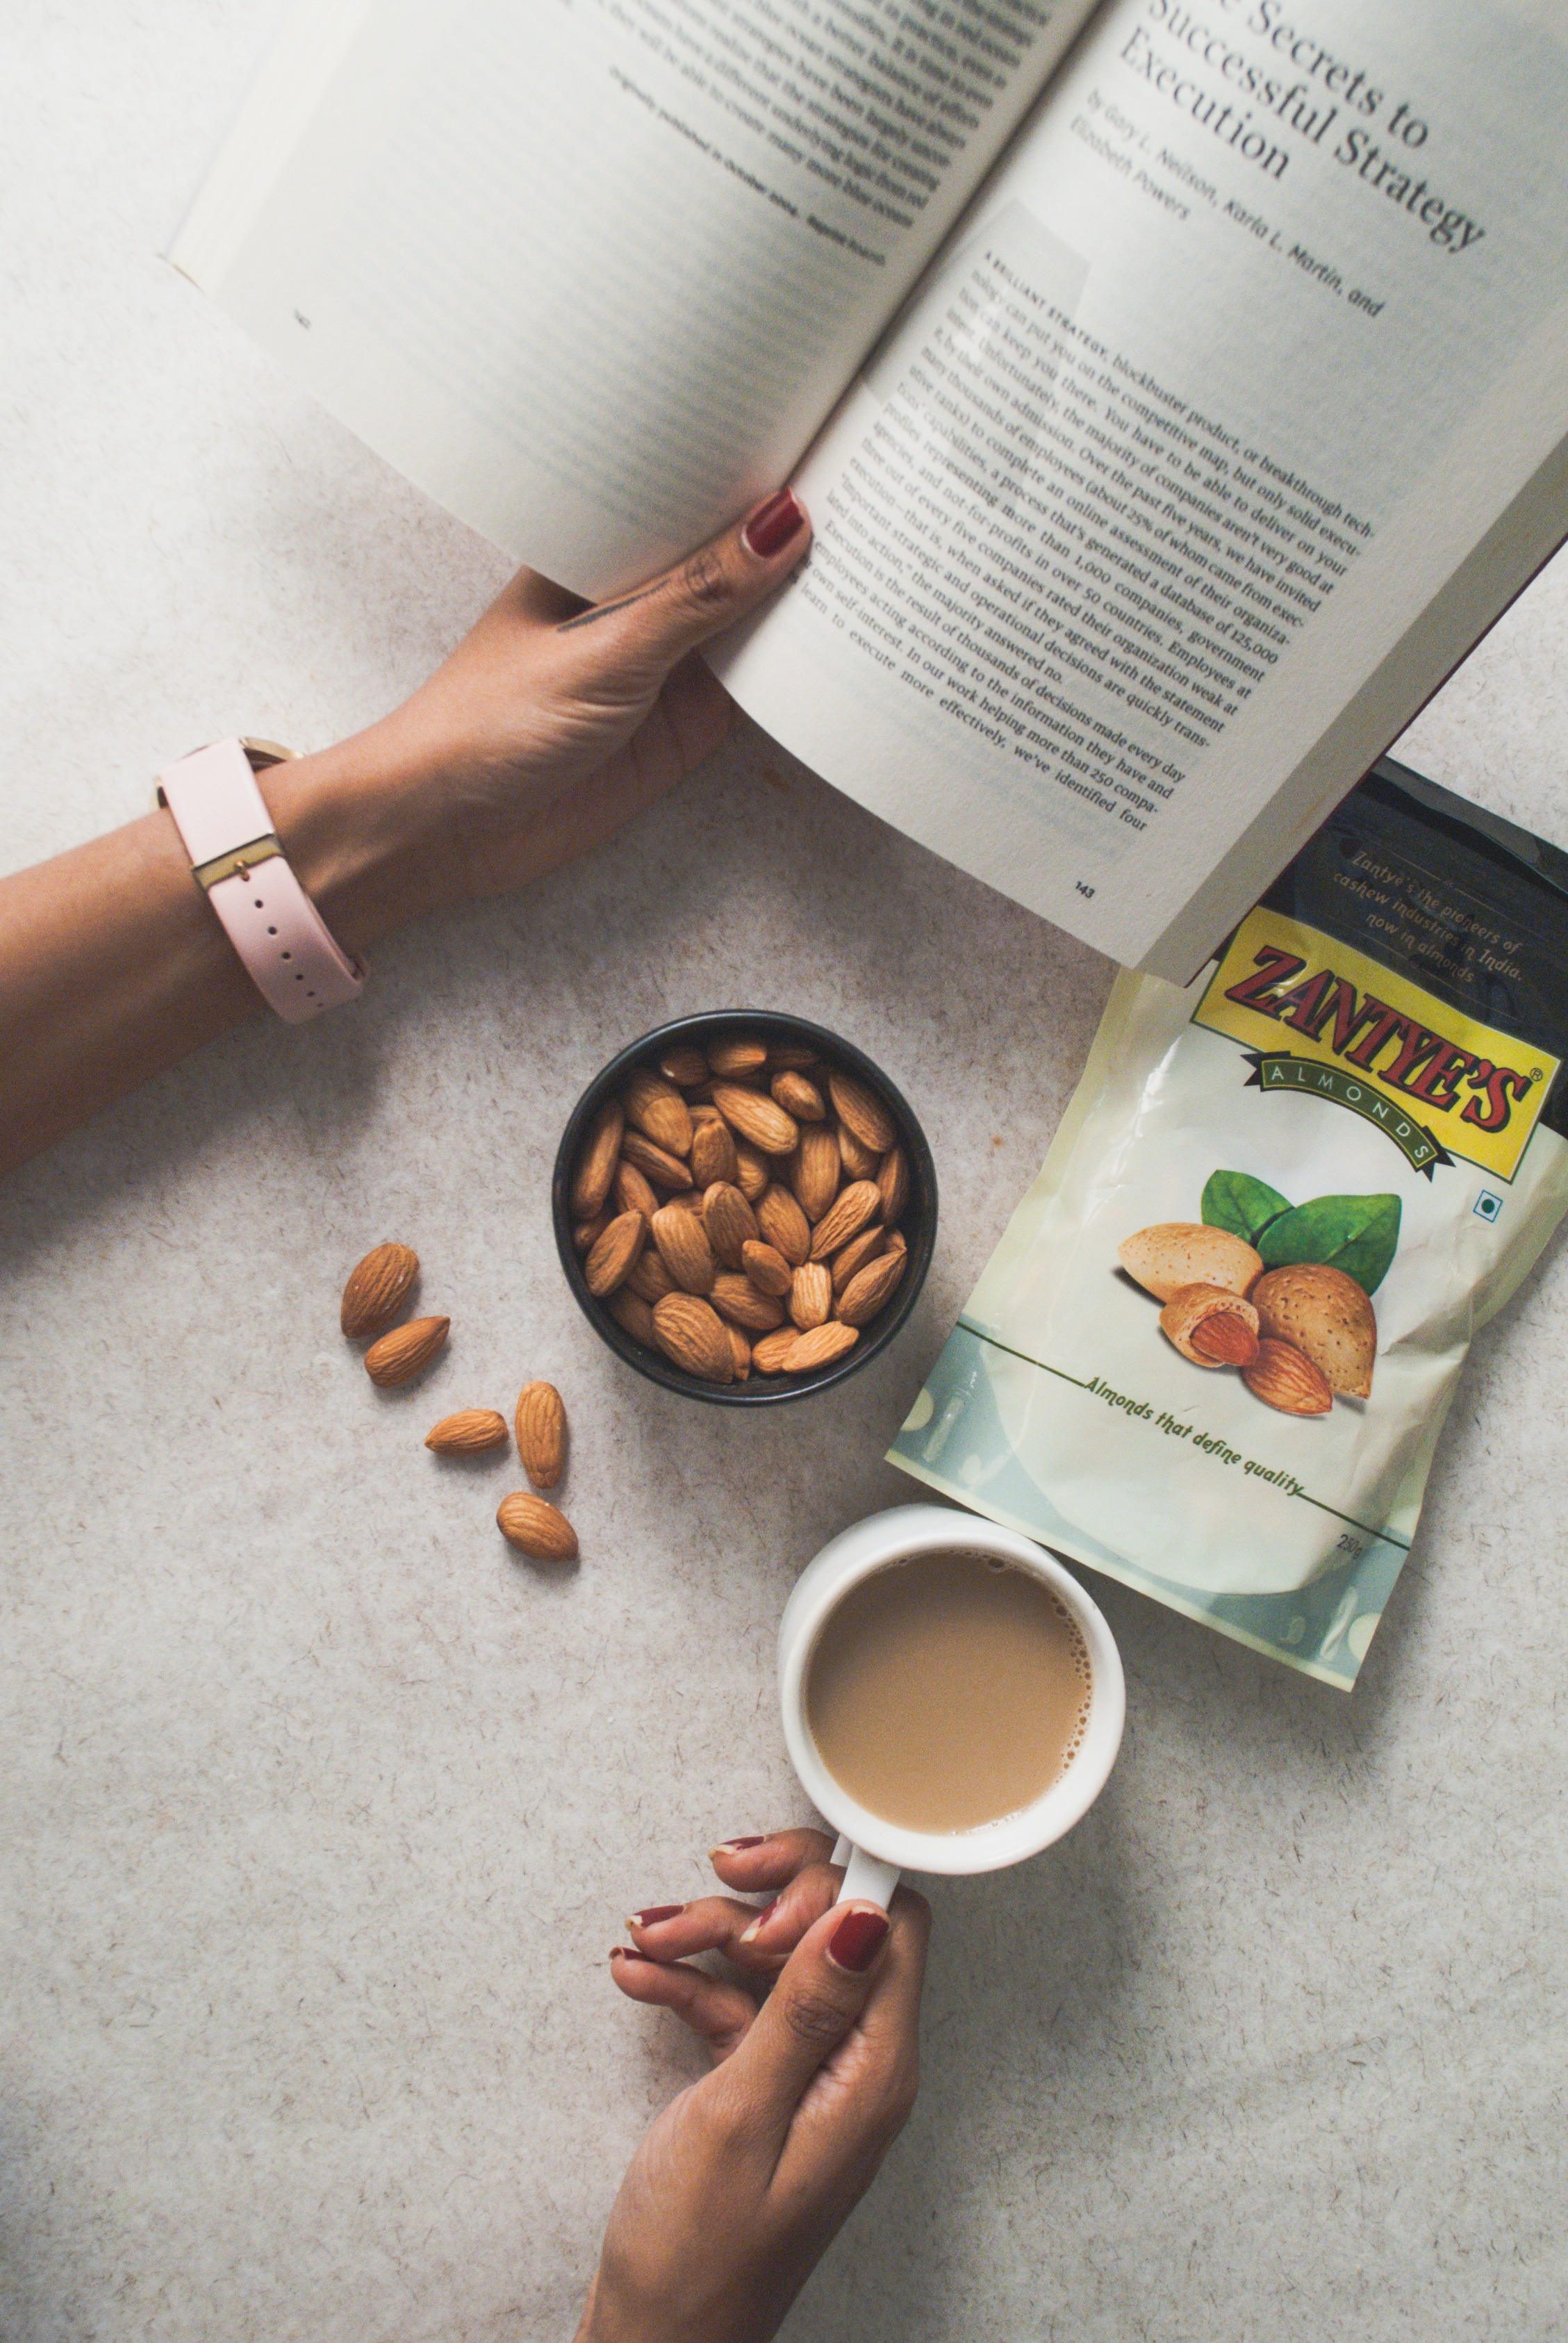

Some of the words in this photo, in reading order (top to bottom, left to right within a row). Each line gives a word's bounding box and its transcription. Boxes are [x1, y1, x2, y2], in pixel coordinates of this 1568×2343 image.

[1119, 24, 1291, 180] Execution
[1149, 0, 1337, 144] Successful
[1334, 127, 1485, 254] Strategy
[1248, 0, 1384, 115] Secrets
[1387, 100, 1428, 148] to
[1069, 115, 1134, 176] Elizabeth
[1133, 169, 1191, 221] Powers
[1156, 147, 1218, 207] Neilson,
[1222, 198, 1269, 240] Karla
[1269, 231, 1283, 251] L.
[1287, 243, 1343, 296] Martin,
[1347, 287, 1387, 318] and
[1062, 405, 1086, 429] the
[1084, 423, 1140, 470] majority
[1139, 461, 1157, 478] of
[1154, 472, 1223, 523] companies
[1221, 516, 1261, 546] aren't
[1259, 541, 1289, 567] very
[1285, 559, 1322, 585] good
[1319, 579, 1335, 594] at
[1096, 372, 1121, 395] the
[1121, 390, 1199, 450] competitive
[1198, 445, 1229, 473] map,
[1232, 464, 1258, 488] but
[1256, 483, 1287, 511] only
[1287, 502, 1322, 529] solid
[1319, 523, 1361, 554] execu-
[1103, 404, 1130, 431] You
[1131, 425, 1165, 456] have
[1166, 450, 1183, 468] to
[1182, 460, 1202, 480] be
[1203, 476, 1233, 500] able
[1232, 494, 1250, 511] to
[1250, 504, 1296, 541] deliver
[1296, 537, 1317, 554] on
[1315, 550, 1348, 575] your
[1111, 352, 1187, 414] blockbuster
[1185, 409, 1241, 453] product,
[1242, 446, 1260, 463] or
[1258, 454, 1345, 518] breakthrough
[1343, 511, 1374, 536] tech-
[1000, 502, 1037, 534] more
[1039, 529, 1072, 558] than
[1074, 554, 1112, 584] 1,000
[1113, 580, 1183, 634] companies,
[1187, 628, 1266, 682] government
[1046, 480, 1065, 498] an
[1065, 493, 1109, 529] online
[1109, 524, 1184, 577] assessment
[1183, 572, 1203, 589] of
[1200, 581, 1232, 609] their
[1232, 603, 1289, 644] organiza-
[1078, 444, 1110, 475] Over
[1109, 468, 1134, 491] the
[1130, 485, 1163, 509] past
[1161, 501, 1187, 526] five
[1185, 520, 1221, 552] years,
[1224, 545, 1246, 564] we
[1244, 555, 1276, 584] have
[1275, 575, 1321, 612] invited
[1082, 477, 1129, 513] (about
[1126, 507, 1157, 532] 25%
[1153, 525, 1172, 542] of
[1168, 535, 1210, 567] whom
[1207, 561, 1243, 589] came
[1241, 579, 1273, 608] from
[1271, 602, 1304, 627] exec-
[1084, 535, 1152, 582] generated
[1160, 580, 1216, 624] database
[1214, 618, 1234, 634] of
[1230, 628, 1279, 664] 125,000
[905, 593, 943, 625] result
[941, 620, 959, 636] of
[956, 629, 1021, 680] thousands
[1019, 674, 1038, 689] of
[1034, 680, 1094, 725] decisions
[1092, 719, 1128, 747] made
[1126, 741, 1163, 771] every
[1161, 759, 1186, 786] day
[910, 568, 933, 593] the
[932, 587, 984, 633] majority
[984, 625, 1046, 671] answered
[1043, 664, 1062, 684] no.
[943, 568, 972, 593] and
[969, 588, 1046, 644] operational
[1043, 636, 1105, 683] decisions
[1103, 677, 1127, 696] are
[1123, 691, 1173, 728] quickly
[1173, 718, 1210, 747] trans-
[946, 543, 982, 576] when
[982, 570, 1023, 603] asked
[1021, 595, 1036, 611] if
[1033, 605, 1064, 635] they
[1064, 627, 1111, 660] agreed
[1108, 655, 1141, 680] with
[1139, 673, 1163, 694] the
[1162, 688, 1225, 733] statement
[952, 517, 978, 545] five
[977, 539, 1046, 593] companies
[1046, 588, 1083, 616] rated
[1080, 609, 1113, 636] their
[1112, 631, 1191, 686] organization
[1190, 680, 1225, 707] weak
[1223, 701, 1239, 716] at
[1034, 551, 1050, 570] in
[1050, 565, 1082, 591] over
[1082, 586, 1103, 604] 50
[1102, 599, 1163, 645] countries.
[1168, 638, 1236, 689] Employees
[1236, 684, 1253, 699] at
[900, 668, 935, 699] more
[938, 696, 1005, 748] effectively,
[1012, 744, 1052, 773] we've
[1054, 767, 1117, 812] identified
[1119, 807, 1147, 832] four
[906, 644, 922, 664] In
[921, 658, 946, 680] our
[945, 675, 980, 702] work
[978, 695, 1027, 737] helping
[1026, 728, 1061, 755] more
[1059, 747, 1091, 773] than
[1090, 767, 1115, 787] 250
[1113, 782, 1157, 813] compa-
[907, 621, 970, 674] according
[969, 664, 987, 682] to
[986, 675, 1010, 698] the
[1010, 690, 1086, 746] information
[1085, 739, 1116, 766] they
[1116, 756, 1148, 784] have
[1147, 778, 1175, 799] and
[1075, 880, 1095, 898] 143
[1334, 872, 1390, 905] cashew
[1392, 898, 1458, 946] industries
[1461, 944, 1476, 961] in
[1478, 948, 1522, 981] India.
[1353, 850, 1414, 894] Zantye's
[1416, 888, 1439, 911] the
[1440, 904, 1501, 945] pioneers
[1503, 939, 1523, 955] of
[1367, 912, 1398, 934] now
[1400, 929, 1415, 950] in
[1418, 942, 1475, 983] almonds
[1224, 945, 1534, 1133] ZANTYE'S
[1271, 1065, 1429, 1158] ALMONDS
[1084, 1376, 1154, 1420] Almonds
[1155, 1412, 1193, 1438] that
[1193, 1432, 1241, 1465] define
[1244, 1460, 1305, 1496] quality
